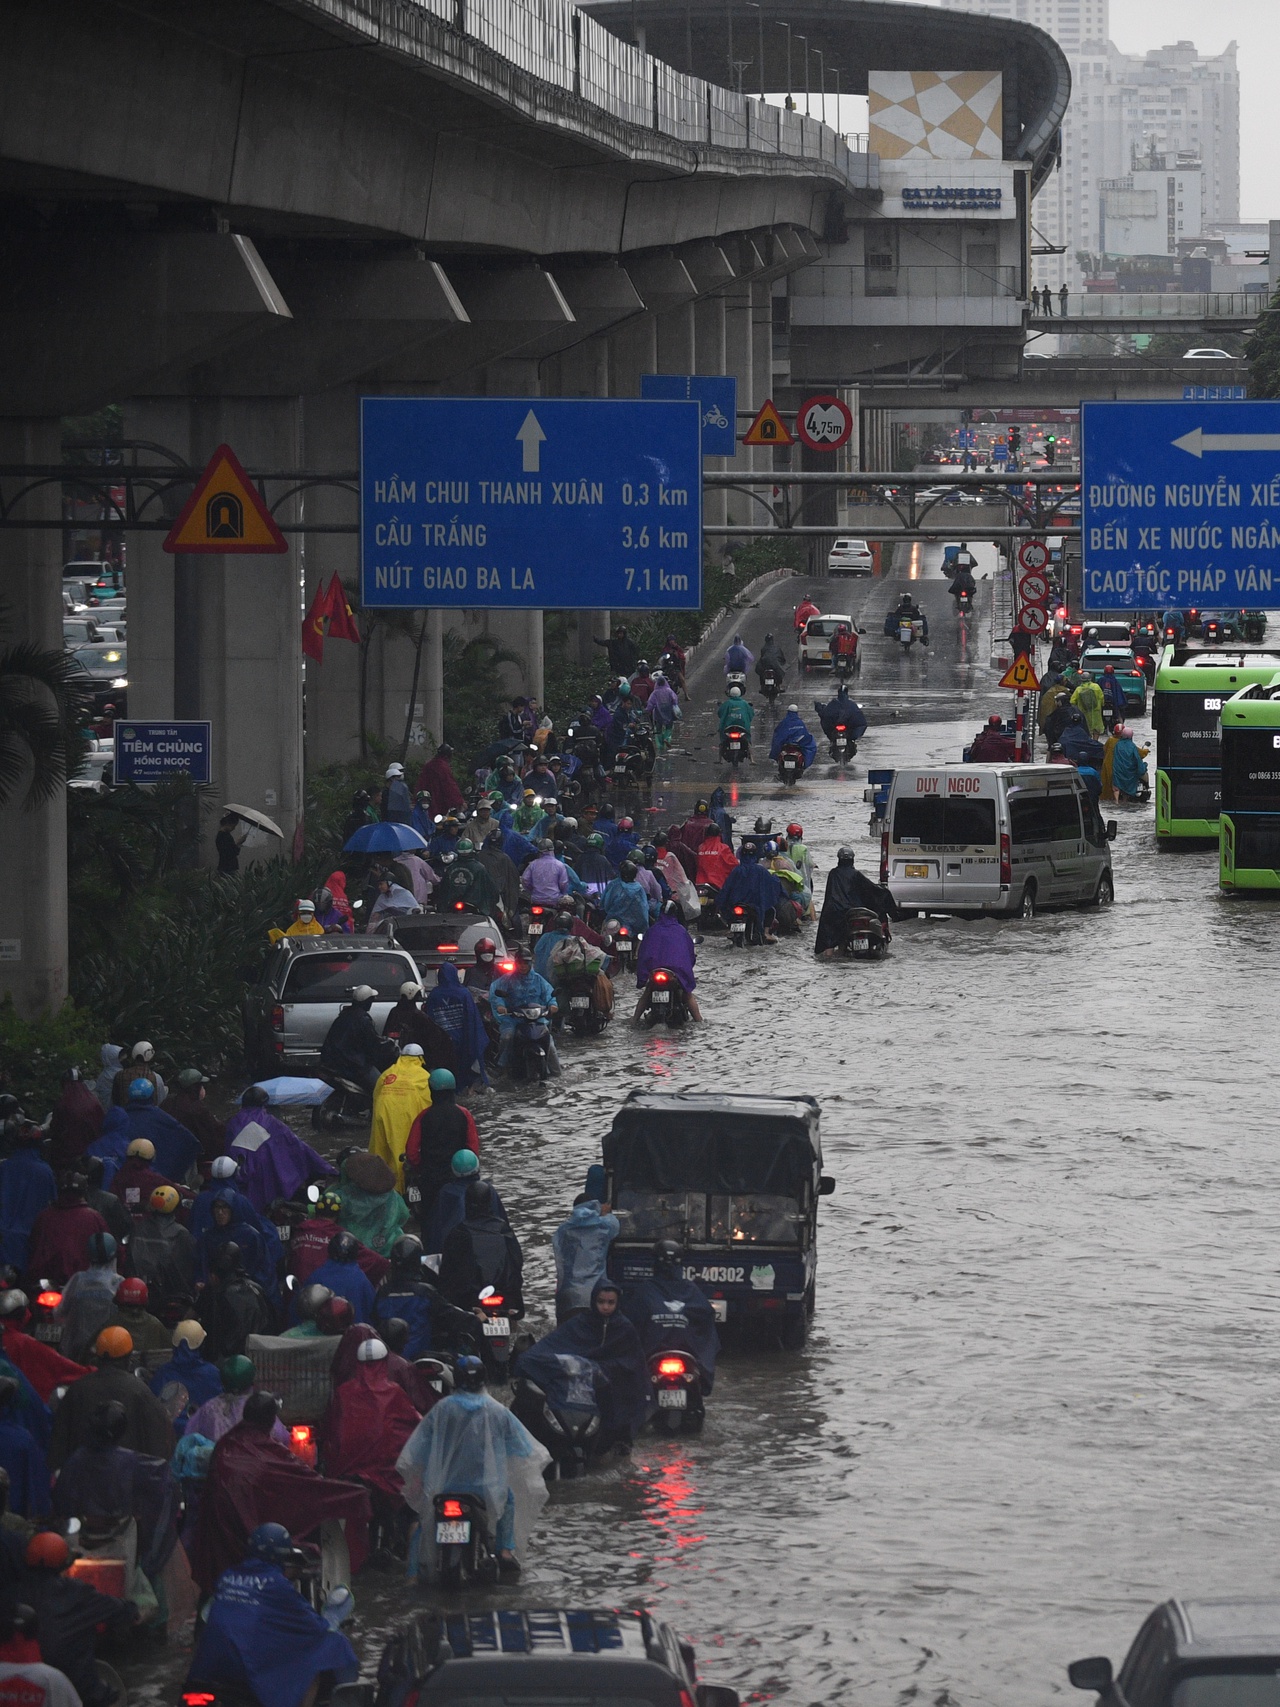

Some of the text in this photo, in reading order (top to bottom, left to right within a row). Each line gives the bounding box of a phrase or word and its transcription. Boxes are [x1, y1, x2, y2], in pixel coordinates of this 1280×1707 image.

[807, 412, 842, 436] 4,75m
[374, 473, 688, 507] HẦM CHUI THANH XUÂN 0,3 km
[1089, 478, 1156, 507] ĐƯỜNG
[1164, 475, 1241, 507] NGUYỄN
[375, 514, 688, 550] CẦU TRẮNG 3,6 km
[1090, 519, 1128, 551] BẾN
[1138, 527, 1162, 550] XE
[1170, 520, 1223, 550] NƯỚC
[375, 560, 688, 593] NÚT GIAO BA LA 7,1 km
[1090, 569, 1128, 592] CAO
[1133, 562, 1171, 593] TỐC
[1177, 563, 1227, 592] PHÁP
[122, 739, 203, 753] TIÊM CHỦNG
[163, 757, 191, 767] NGỌC
[916, 777, 939, 792] DUY
